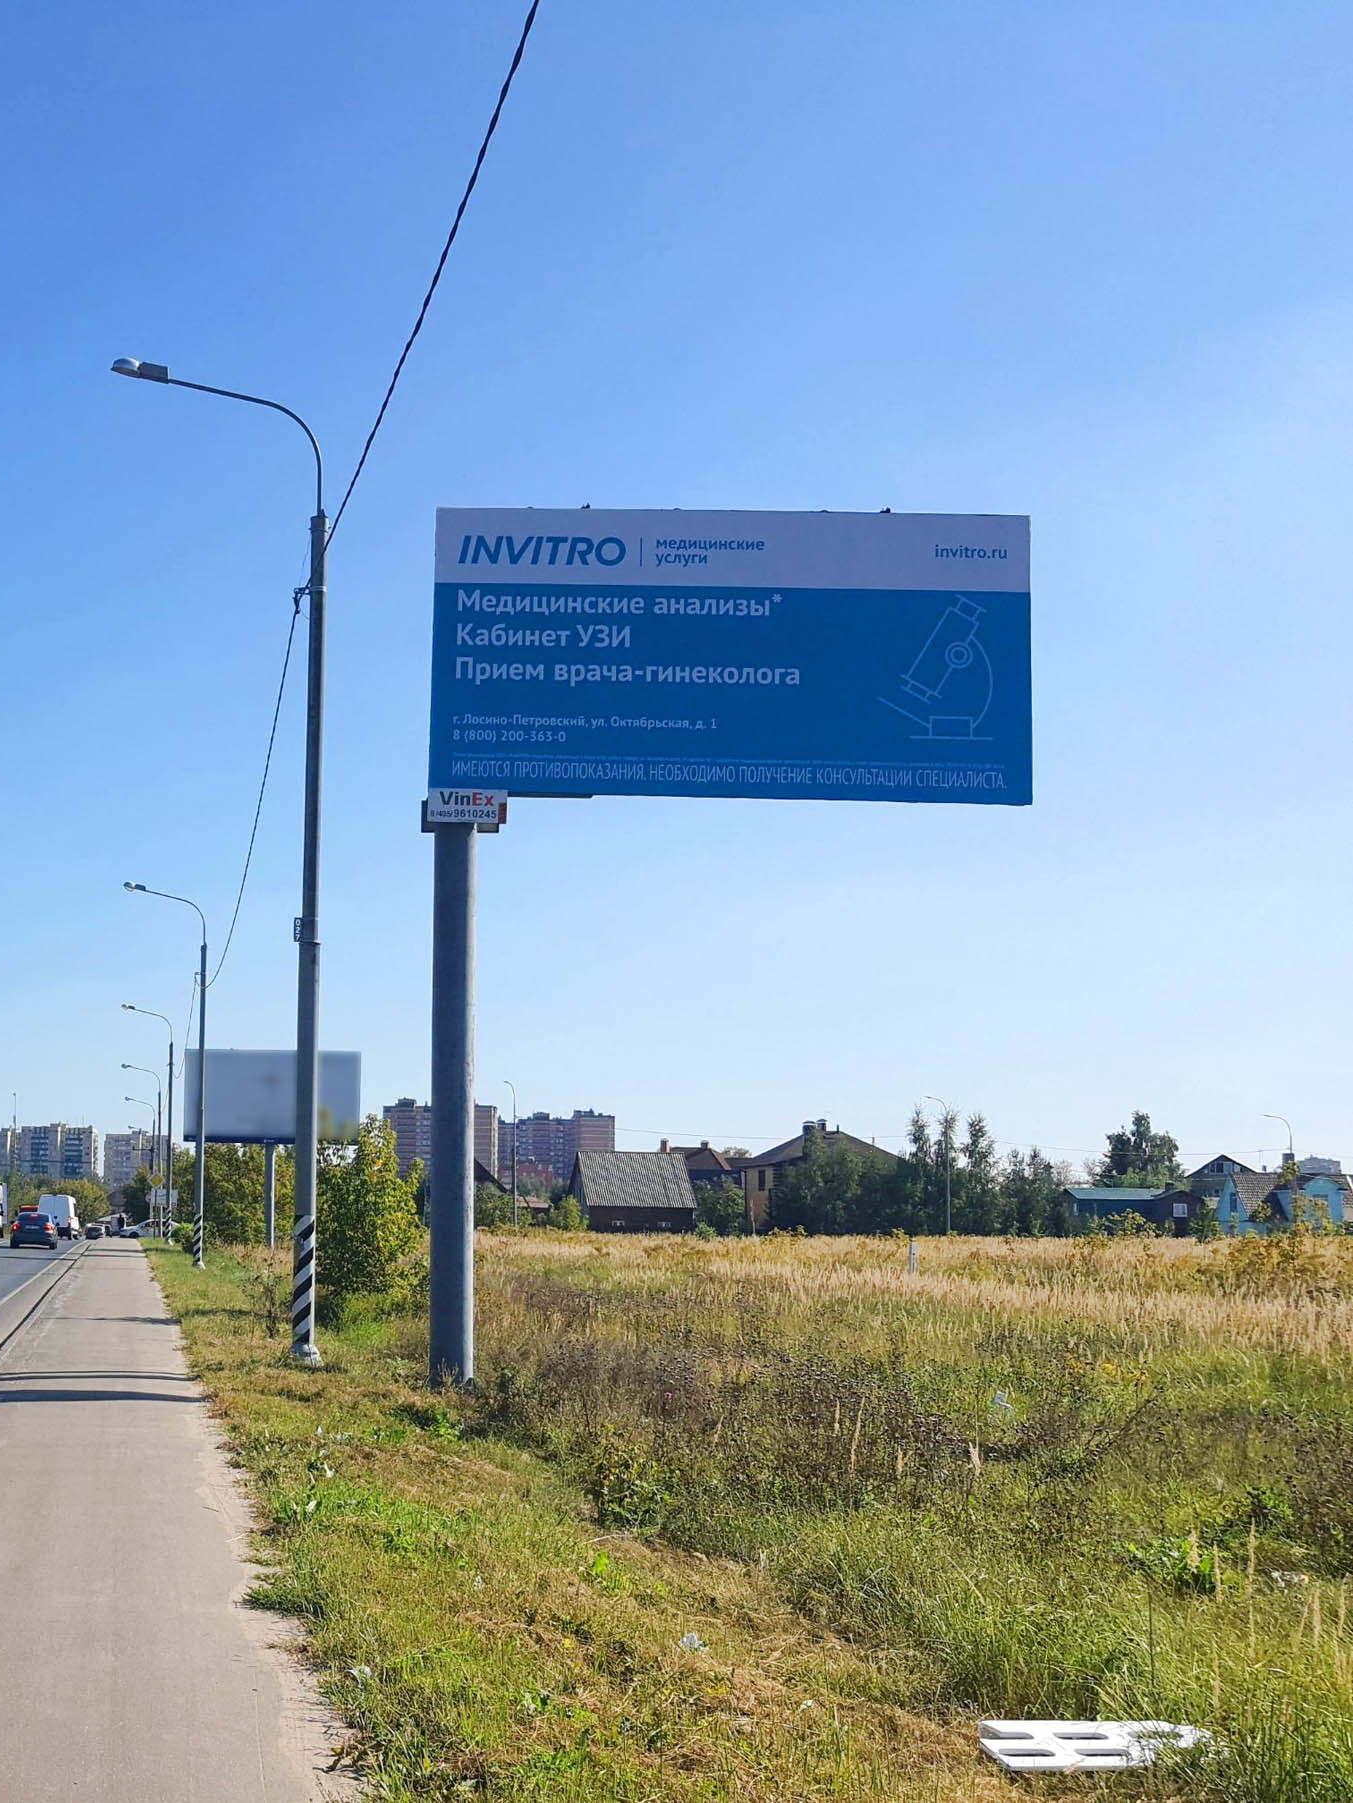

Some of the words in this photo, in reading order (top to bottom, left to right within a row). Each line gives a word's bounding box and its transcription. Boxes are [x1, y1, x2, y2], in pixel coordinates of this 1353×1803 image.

[457, 535, 627, 566] INVITRO
[656, 537, 765, 551] медицинские
[935, 544, 1008, 559] invitro.ru
[655, 552, 708, 567] услуги
[457, 589, 645, 616] Медицинские
[456, 623, 570, 647] Кабинет
[576, 625, 631, 648] УЗИ
[455, 656, 545, 685] Прием
[554, 663, 800, 687] врача-гинеколога
[452, 716, 461, 724] г.
[463, 714, 589, 728] Лосино-Петровский,
[591, 718, 608, 730] ул.
[611, 716, 692, 730] Октябрьская,
[695, 719, 706, 730] д.
[710, 719, 717, 729] 1
[452, 730, 460, 740] 8
[464, 730, 496, 743] (800)
[501, 731, 566, 742] 200-363-0
[452, 760, 510, 778] ИМЕЮТСЯ
[514, 761, 647, 781] ПРОТИВОПОКАЗАНИЯ.
[650, 763, 735, 784] НЕОБХОДИМО
[739, 766, 812, 784] ПОЛУЧЕНИЕ
[816, 767, 912, 788] КОНСУЛЬТАЦИИ
[916, 769, 1007, 790] СПЕЦИАЛИСТА.
[439, 790, 494, 807] VinEx
